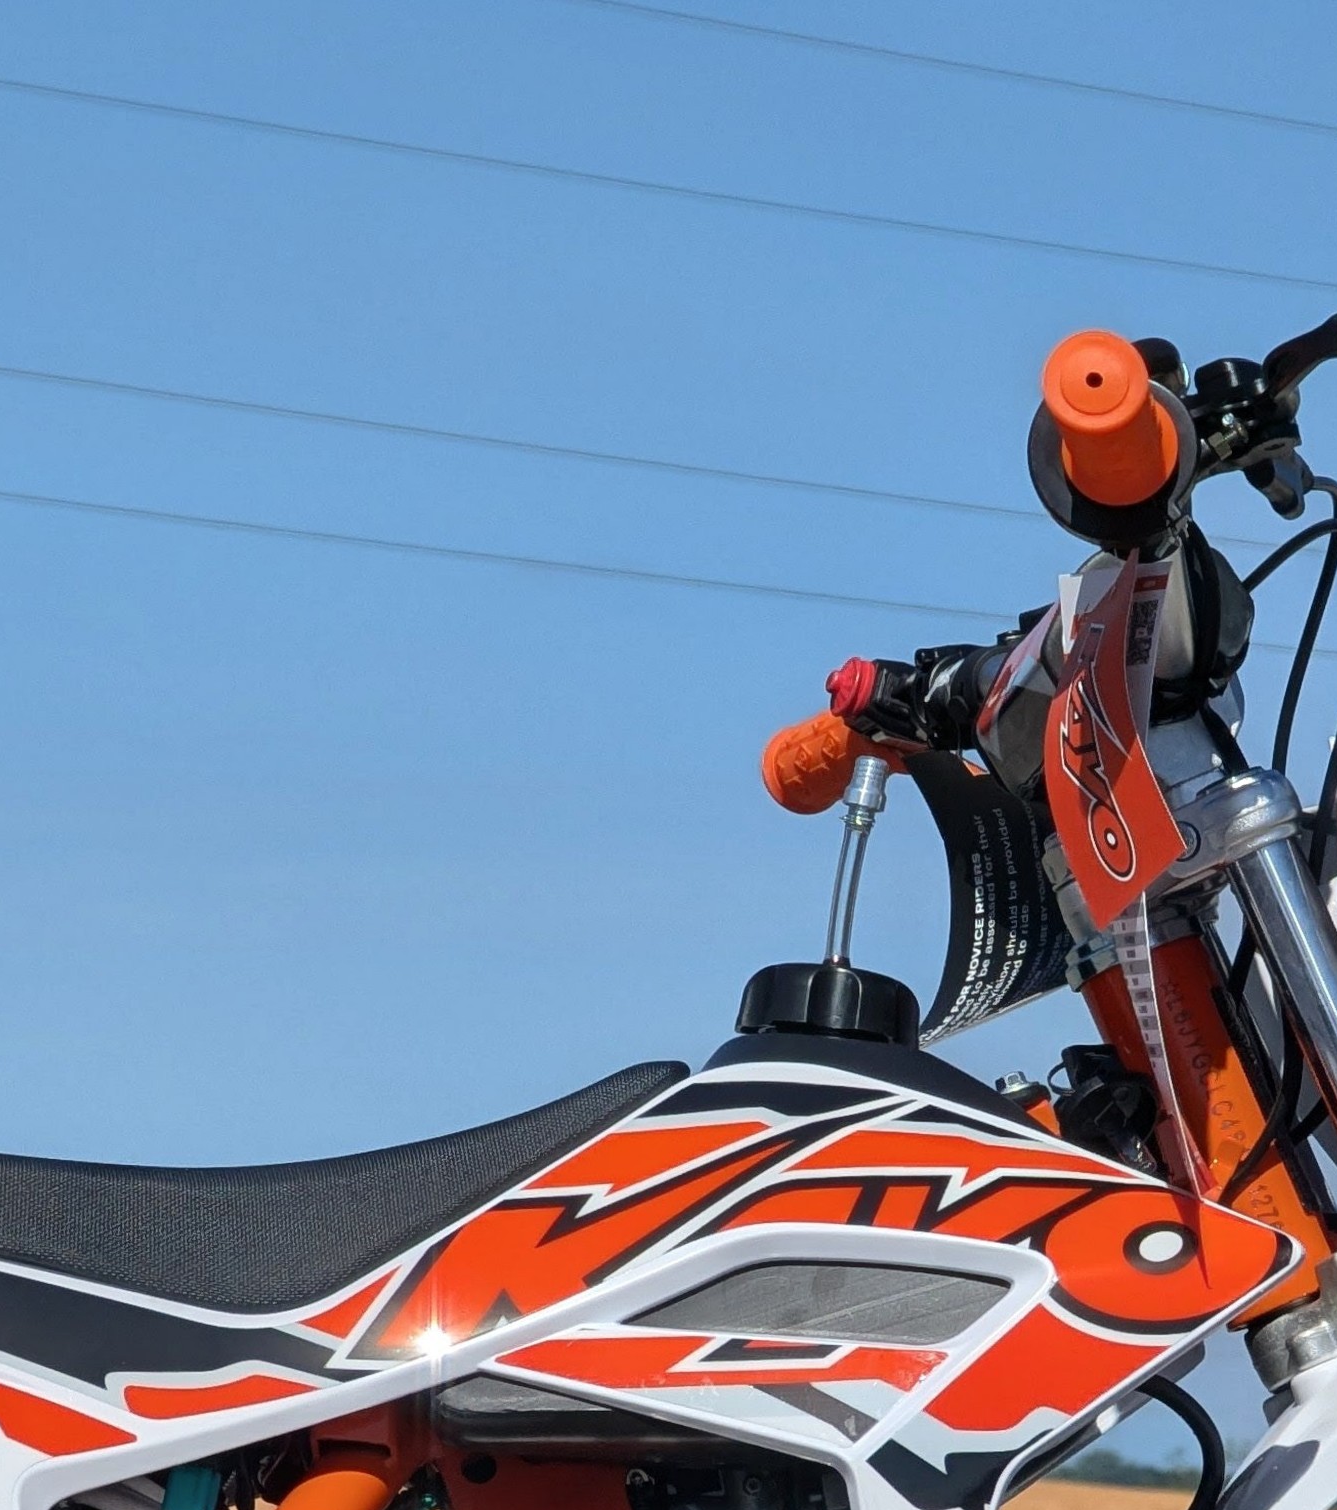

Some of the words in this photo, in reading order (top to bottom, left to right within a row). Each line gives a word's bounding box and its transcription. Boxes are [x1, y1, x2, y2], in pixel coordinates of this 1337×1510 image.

[992, 807, 1018, 875] provided
[972, 853, 984, 914] RIDERS
[964, 918, 984, 982] NOVICE
[984, 882, 996, 954] assessed
[1005, 905, 1018, 956] should
